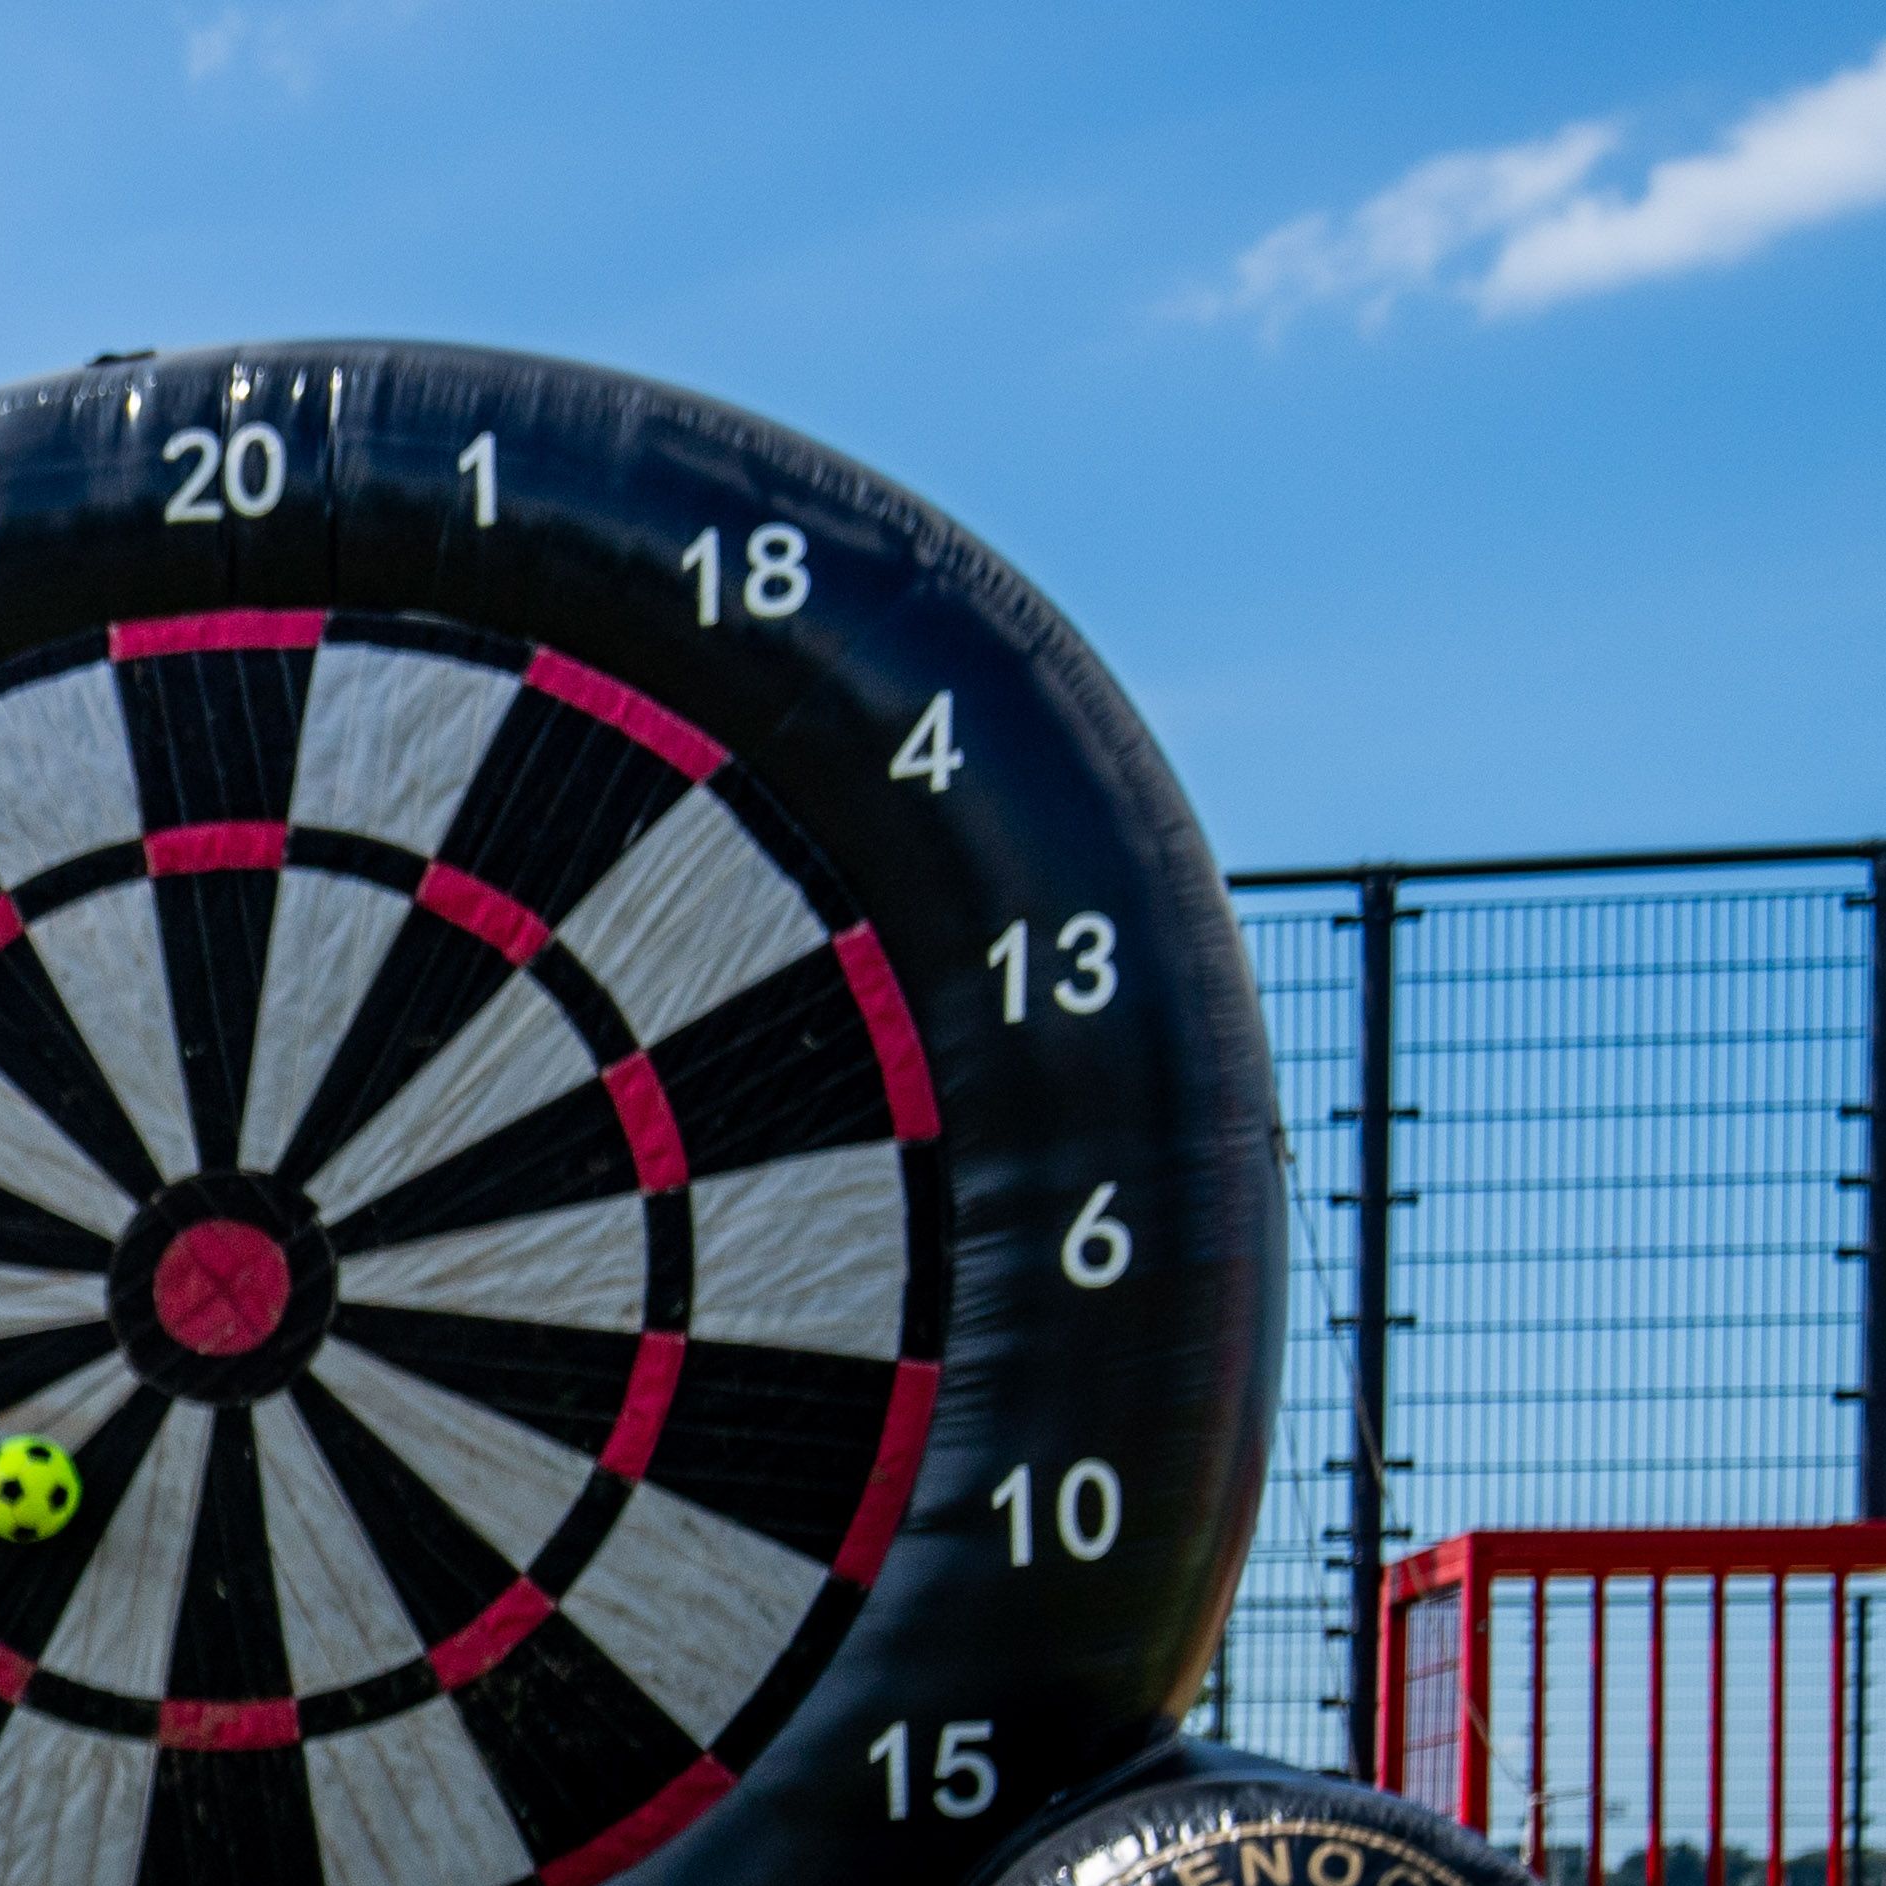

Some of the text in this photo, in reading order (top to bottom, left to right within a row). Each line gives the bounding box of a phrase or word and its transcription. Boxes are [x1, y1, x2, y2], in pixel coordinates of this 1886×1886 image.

[162, 423, 286, 524] 20
[457, 432, 497, 527] 1
[680, 525, 810, 627] 18
[888, 692, 964, 793] 4
[987, 914, 1117, 1024] 13
[1061, 1183, 1131, 1287] 6
[991, 1461, 1120, 1566] 10
[868, 1720, 998, 1821] 15
